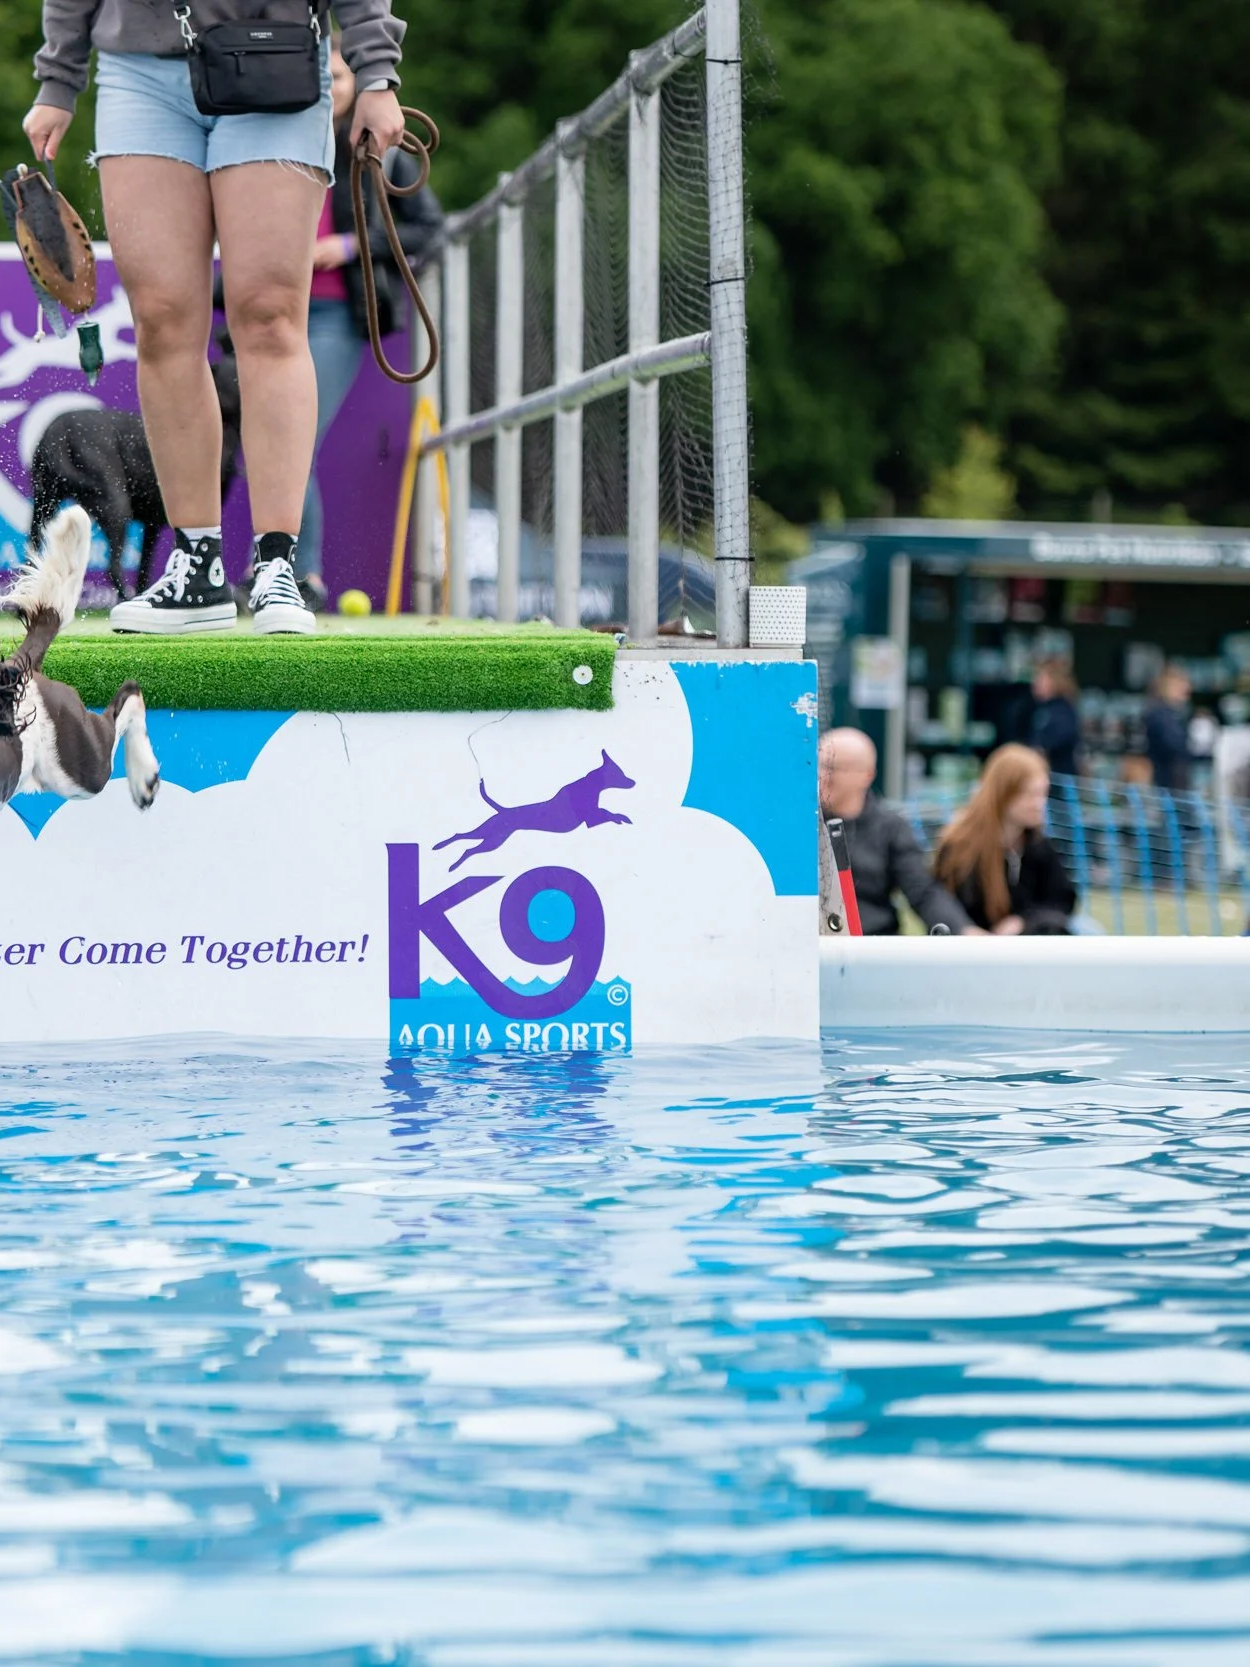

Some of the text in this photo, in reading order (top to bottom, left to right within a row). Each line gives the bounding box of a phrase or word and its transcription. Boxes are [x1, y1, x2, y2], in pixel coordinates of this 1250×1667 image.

[385, 843, 606, 1021] K9
[58, 935, 167, 965] Come
[181, 933, 370, 970] Together!
[505, 1021, 627, 1051] SPORTS
